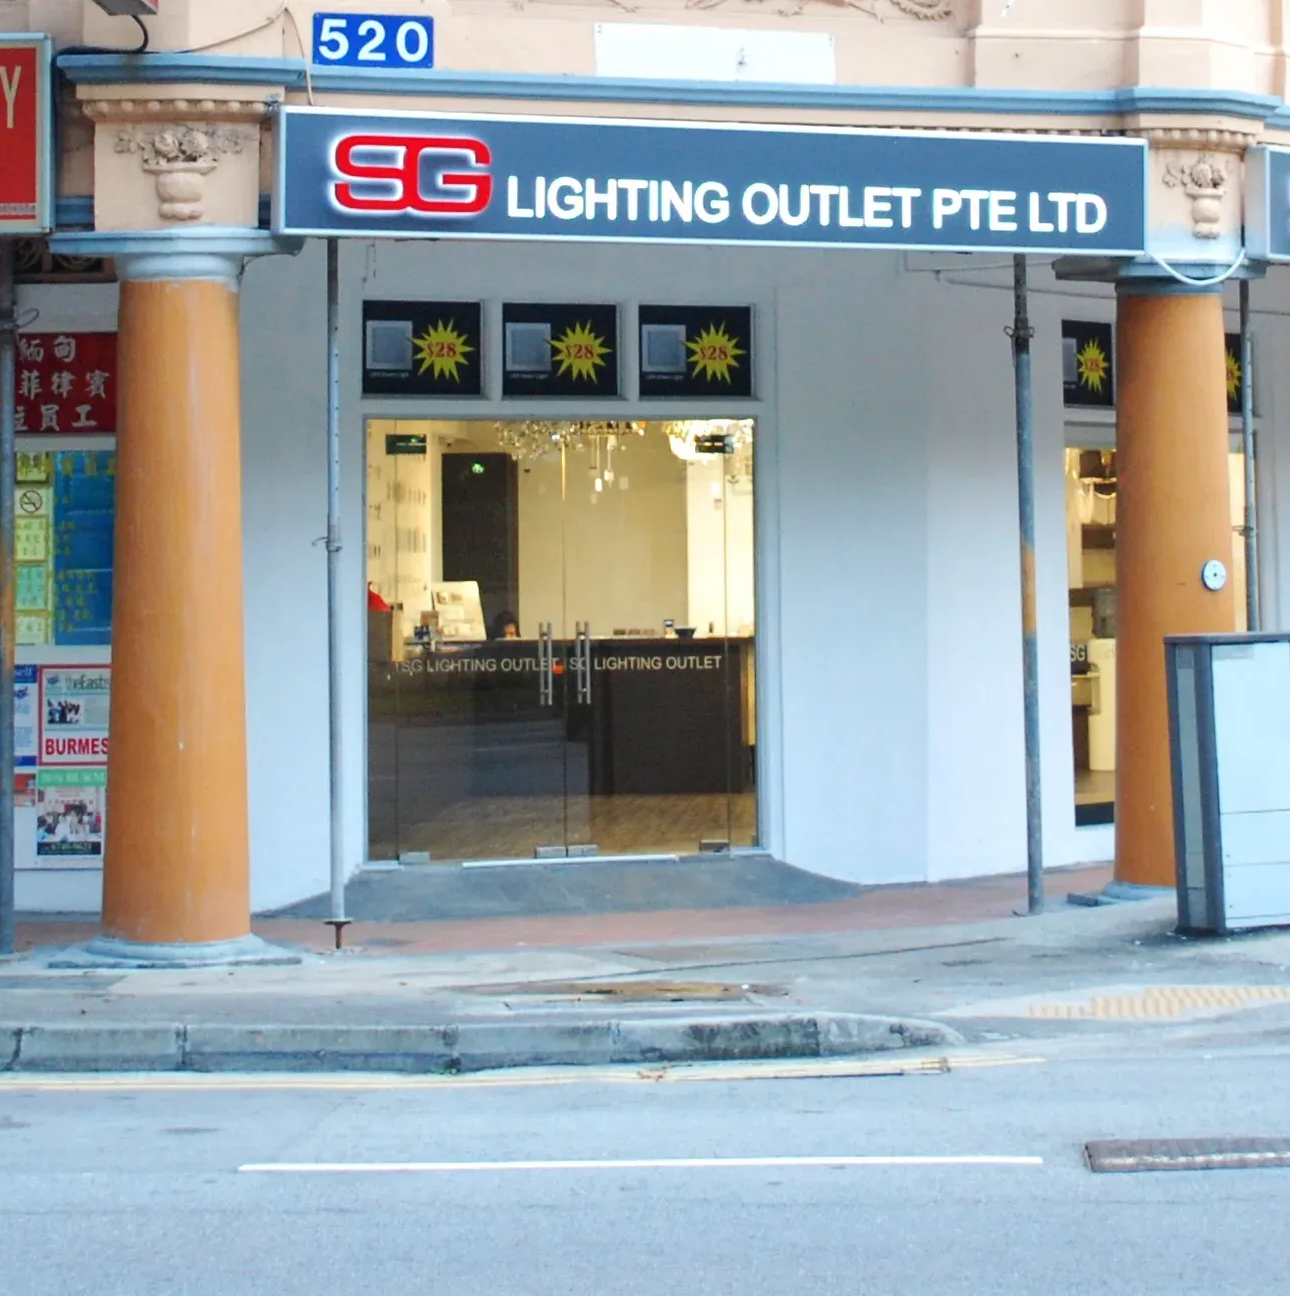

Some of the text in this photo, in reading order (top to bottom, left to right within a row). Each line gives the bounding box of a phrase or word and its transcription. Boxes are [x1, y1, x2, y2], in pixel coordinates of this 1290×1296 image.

[317, 17, 430, 61] 520
[333, 133, 1109, 236] SG LIGHTING OUTLET PTE LTD
[427, 340, 457, 357] $28
[565, 343, 595, 359] $28
[699, 345, 729, 361] $28
[19, 369, 110, 401] 菲律賓
[426, 657, 497, 672] LIGHTING
[594, 656, 663, 671] LIGHTING
[666, 655, 723, 669] OUTLET
